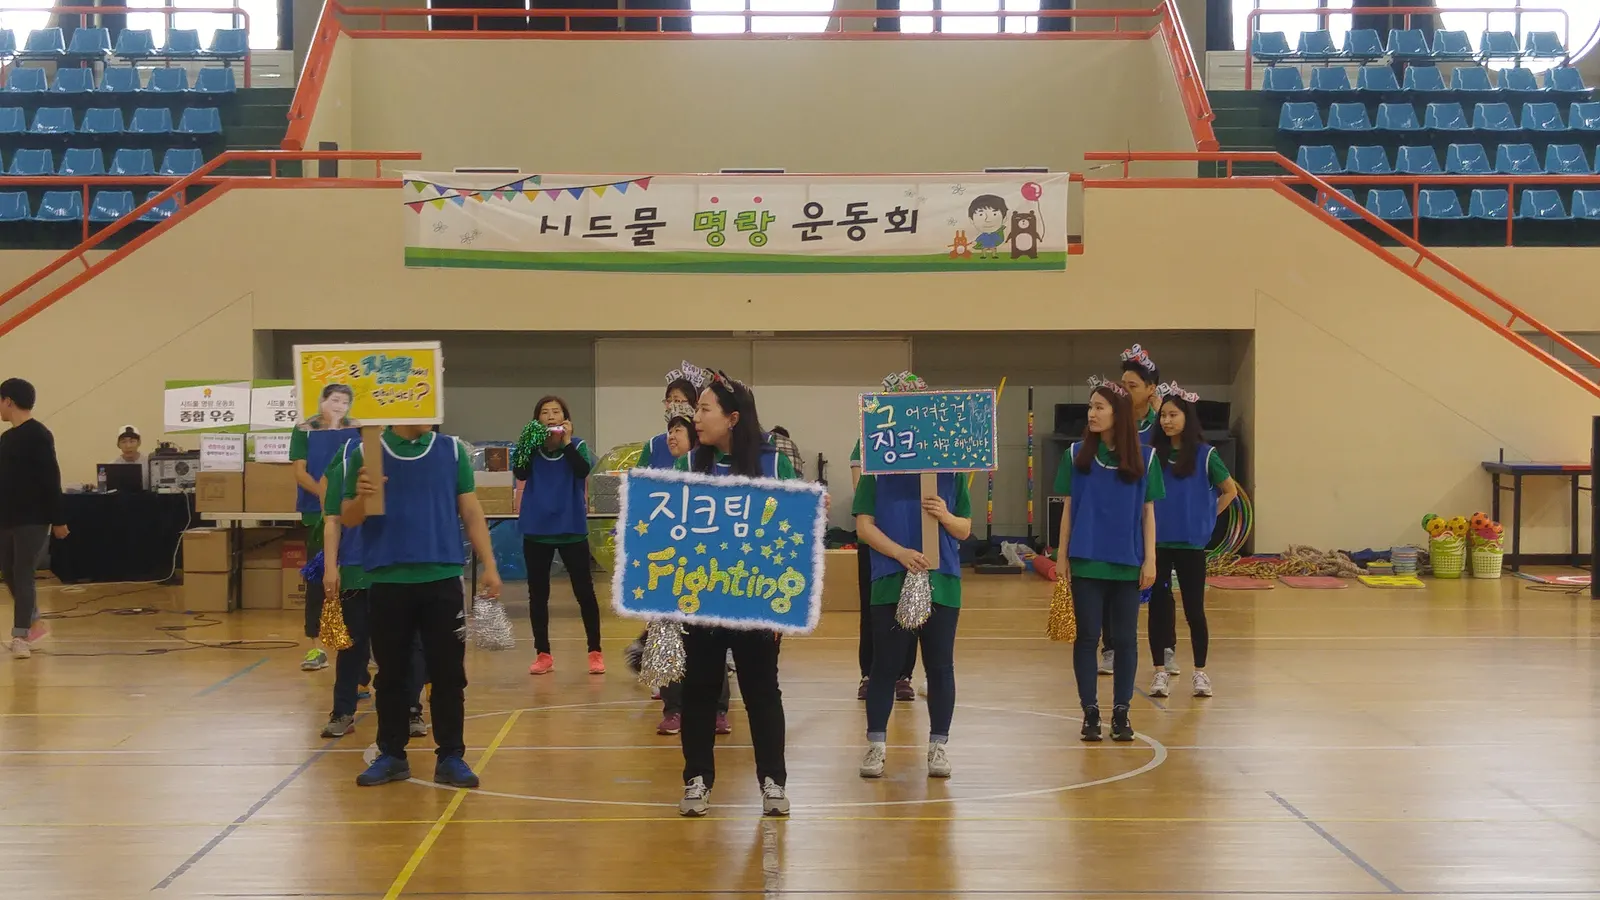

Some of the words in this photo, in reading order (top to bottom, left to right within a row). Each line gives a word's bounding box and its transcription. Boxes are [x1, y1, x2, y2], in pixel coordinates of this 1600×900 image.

[540, 207, 667, 247] 시드물
[693, 208, 776, 247] 명랑
[791, 201, 920, 242] 운동회
[180, 400, 199, 408] 시드물
[201, 400, 214, 408] 명랑
[215, 400, 235, 408] 운동회
[180, 410, 205, 423] 종합
[210, 410, 235, 422] 우승
[275, 410, 298, 422] 준우
[876, 405, 897, 429] 그
[933, 438, 950, 451] 자꾸
[954, 436, 989, 452] 해냅니다
[649, 485, 778, 541] 징크팀!
[647, 546, 806, 614] Fighting
